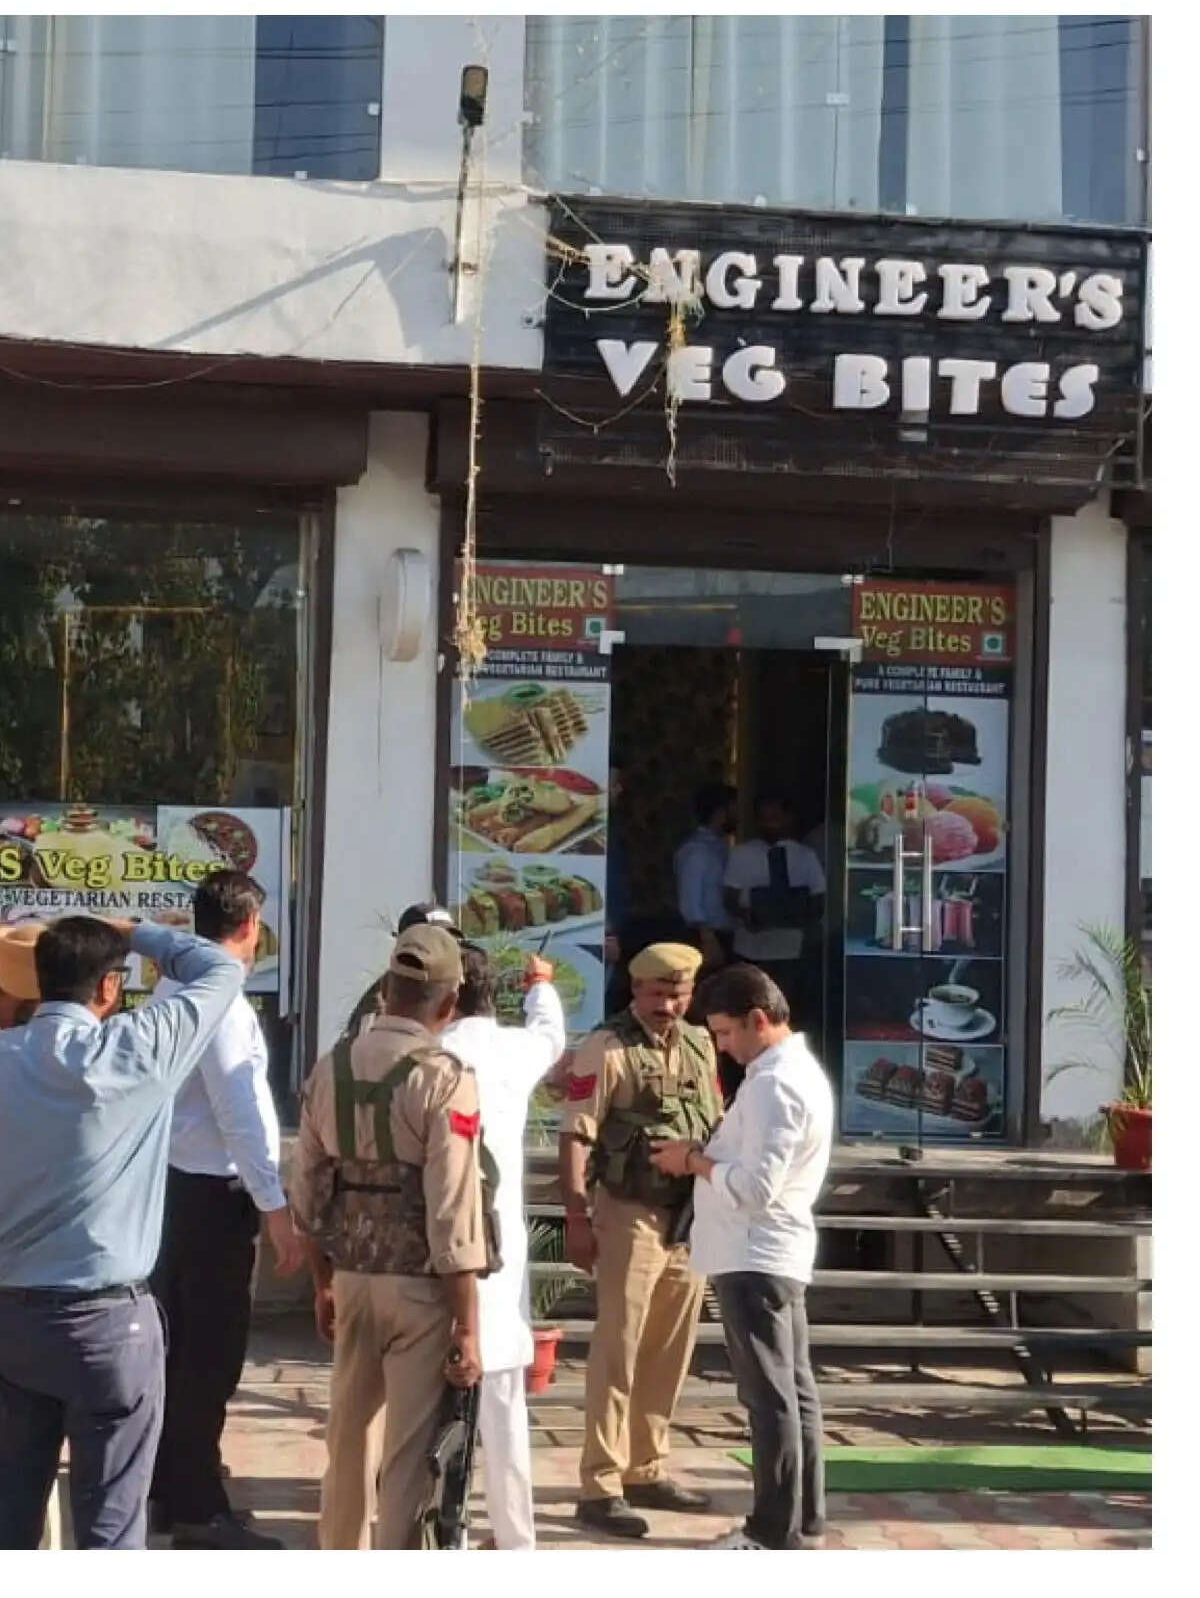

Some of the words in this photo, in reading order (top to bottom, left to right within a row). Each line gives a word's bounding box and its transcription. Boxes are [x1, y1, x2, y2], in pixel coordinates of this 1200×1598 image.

[583, 243, 1124, 331] ENGINEER'S
[596, 338, 786, 401] VEG
[833, 354, 1100, 419] BITES
[509, 611, 574, 638] Bites
[860, 590, 1007, 626] ENGINEER'S
[861, 625, 904, 657] Veg
[909, 625, 973, 653] Bites
[35, 849, 112, 887] Veg
[12, 888, 131, 908] VEGETARIAN
